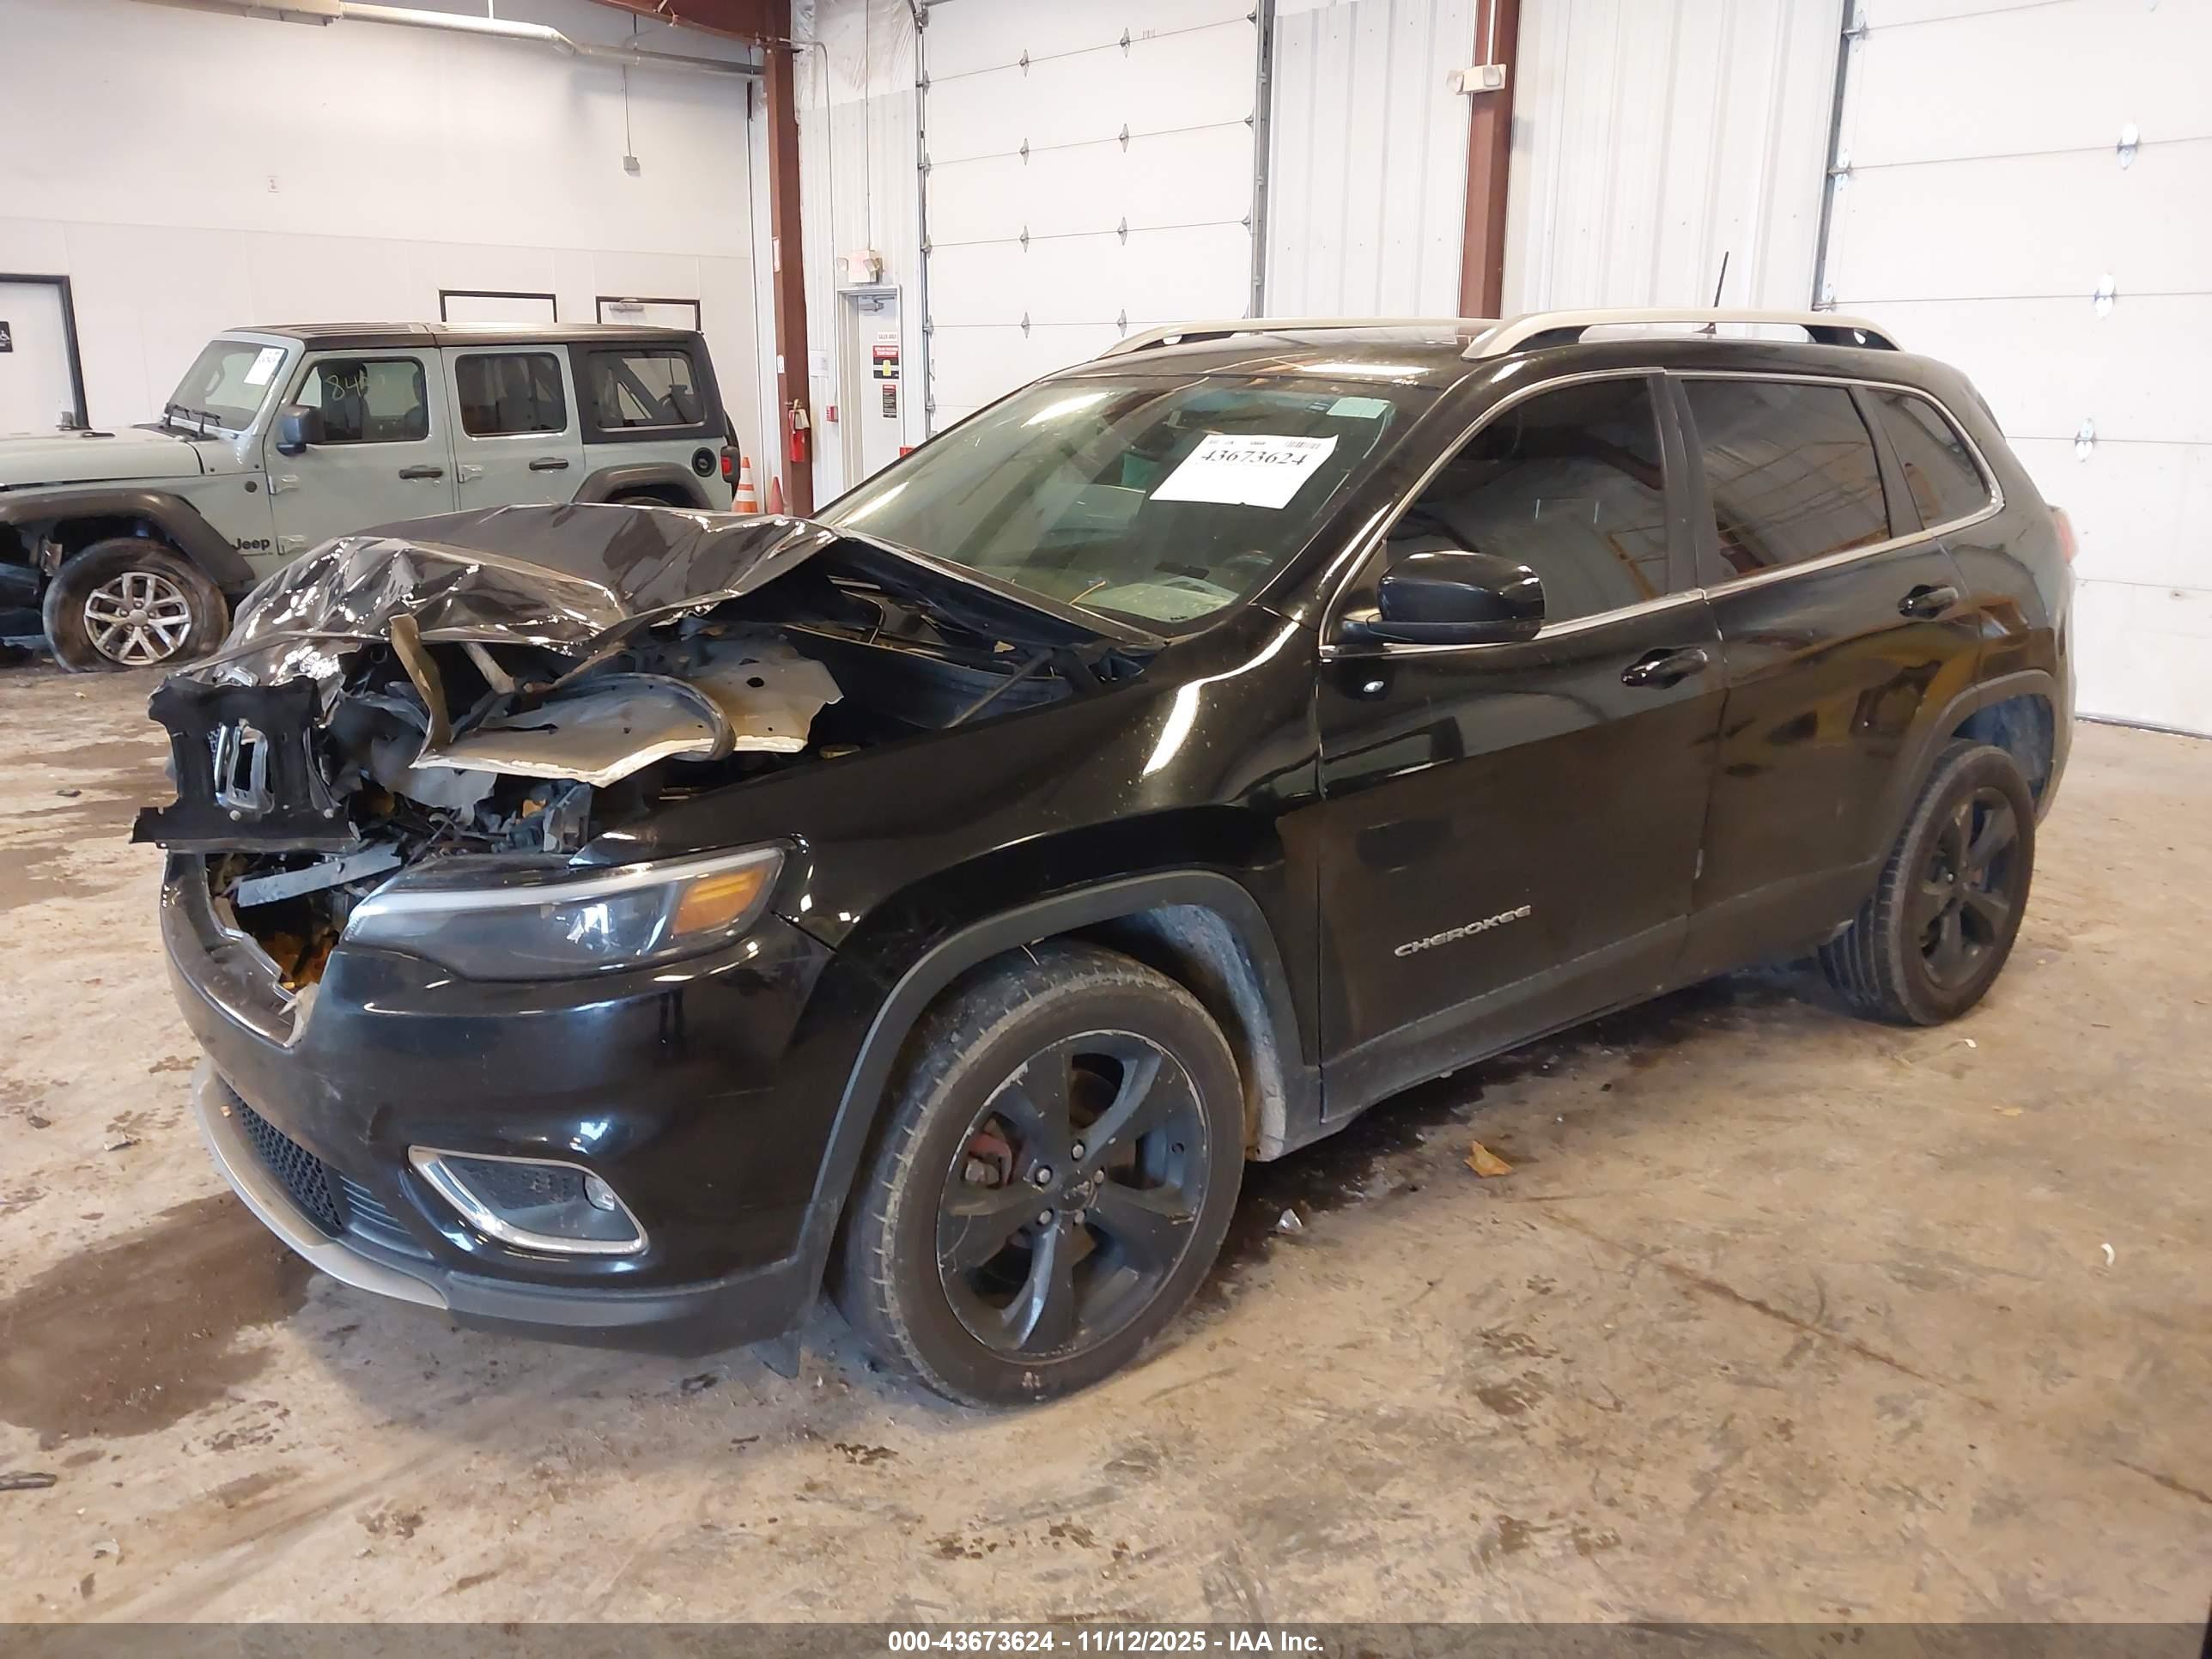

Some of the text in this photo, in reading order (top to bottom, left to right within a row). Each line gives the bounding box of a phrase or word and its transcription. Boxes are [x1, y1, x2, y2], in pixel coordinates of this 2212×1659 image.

[1200, 448, 1309, 466] 43673624
[231, 538, 270, 551] Jeep
[1394, 904, 1532, 957] CHEROKEE
